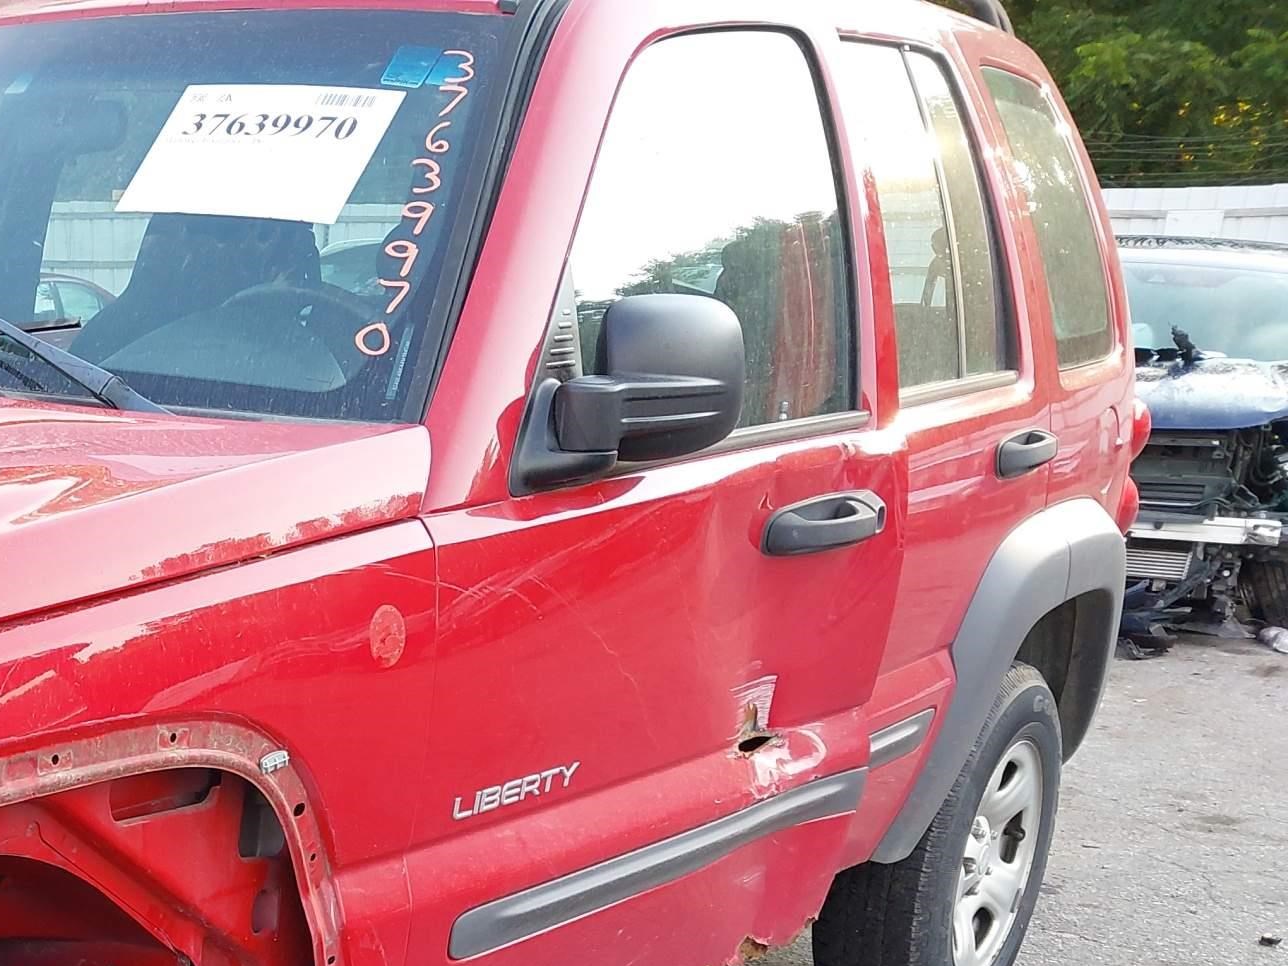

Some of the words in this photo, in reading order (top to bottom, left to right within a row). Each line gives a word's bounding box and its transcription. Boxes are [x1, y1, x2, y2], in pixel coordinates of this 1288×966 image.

[181, 113, 358, 140] 37639970
[354, 48, 476, 356] 37639970
[452, 760, 581, 820] LIBERTY
